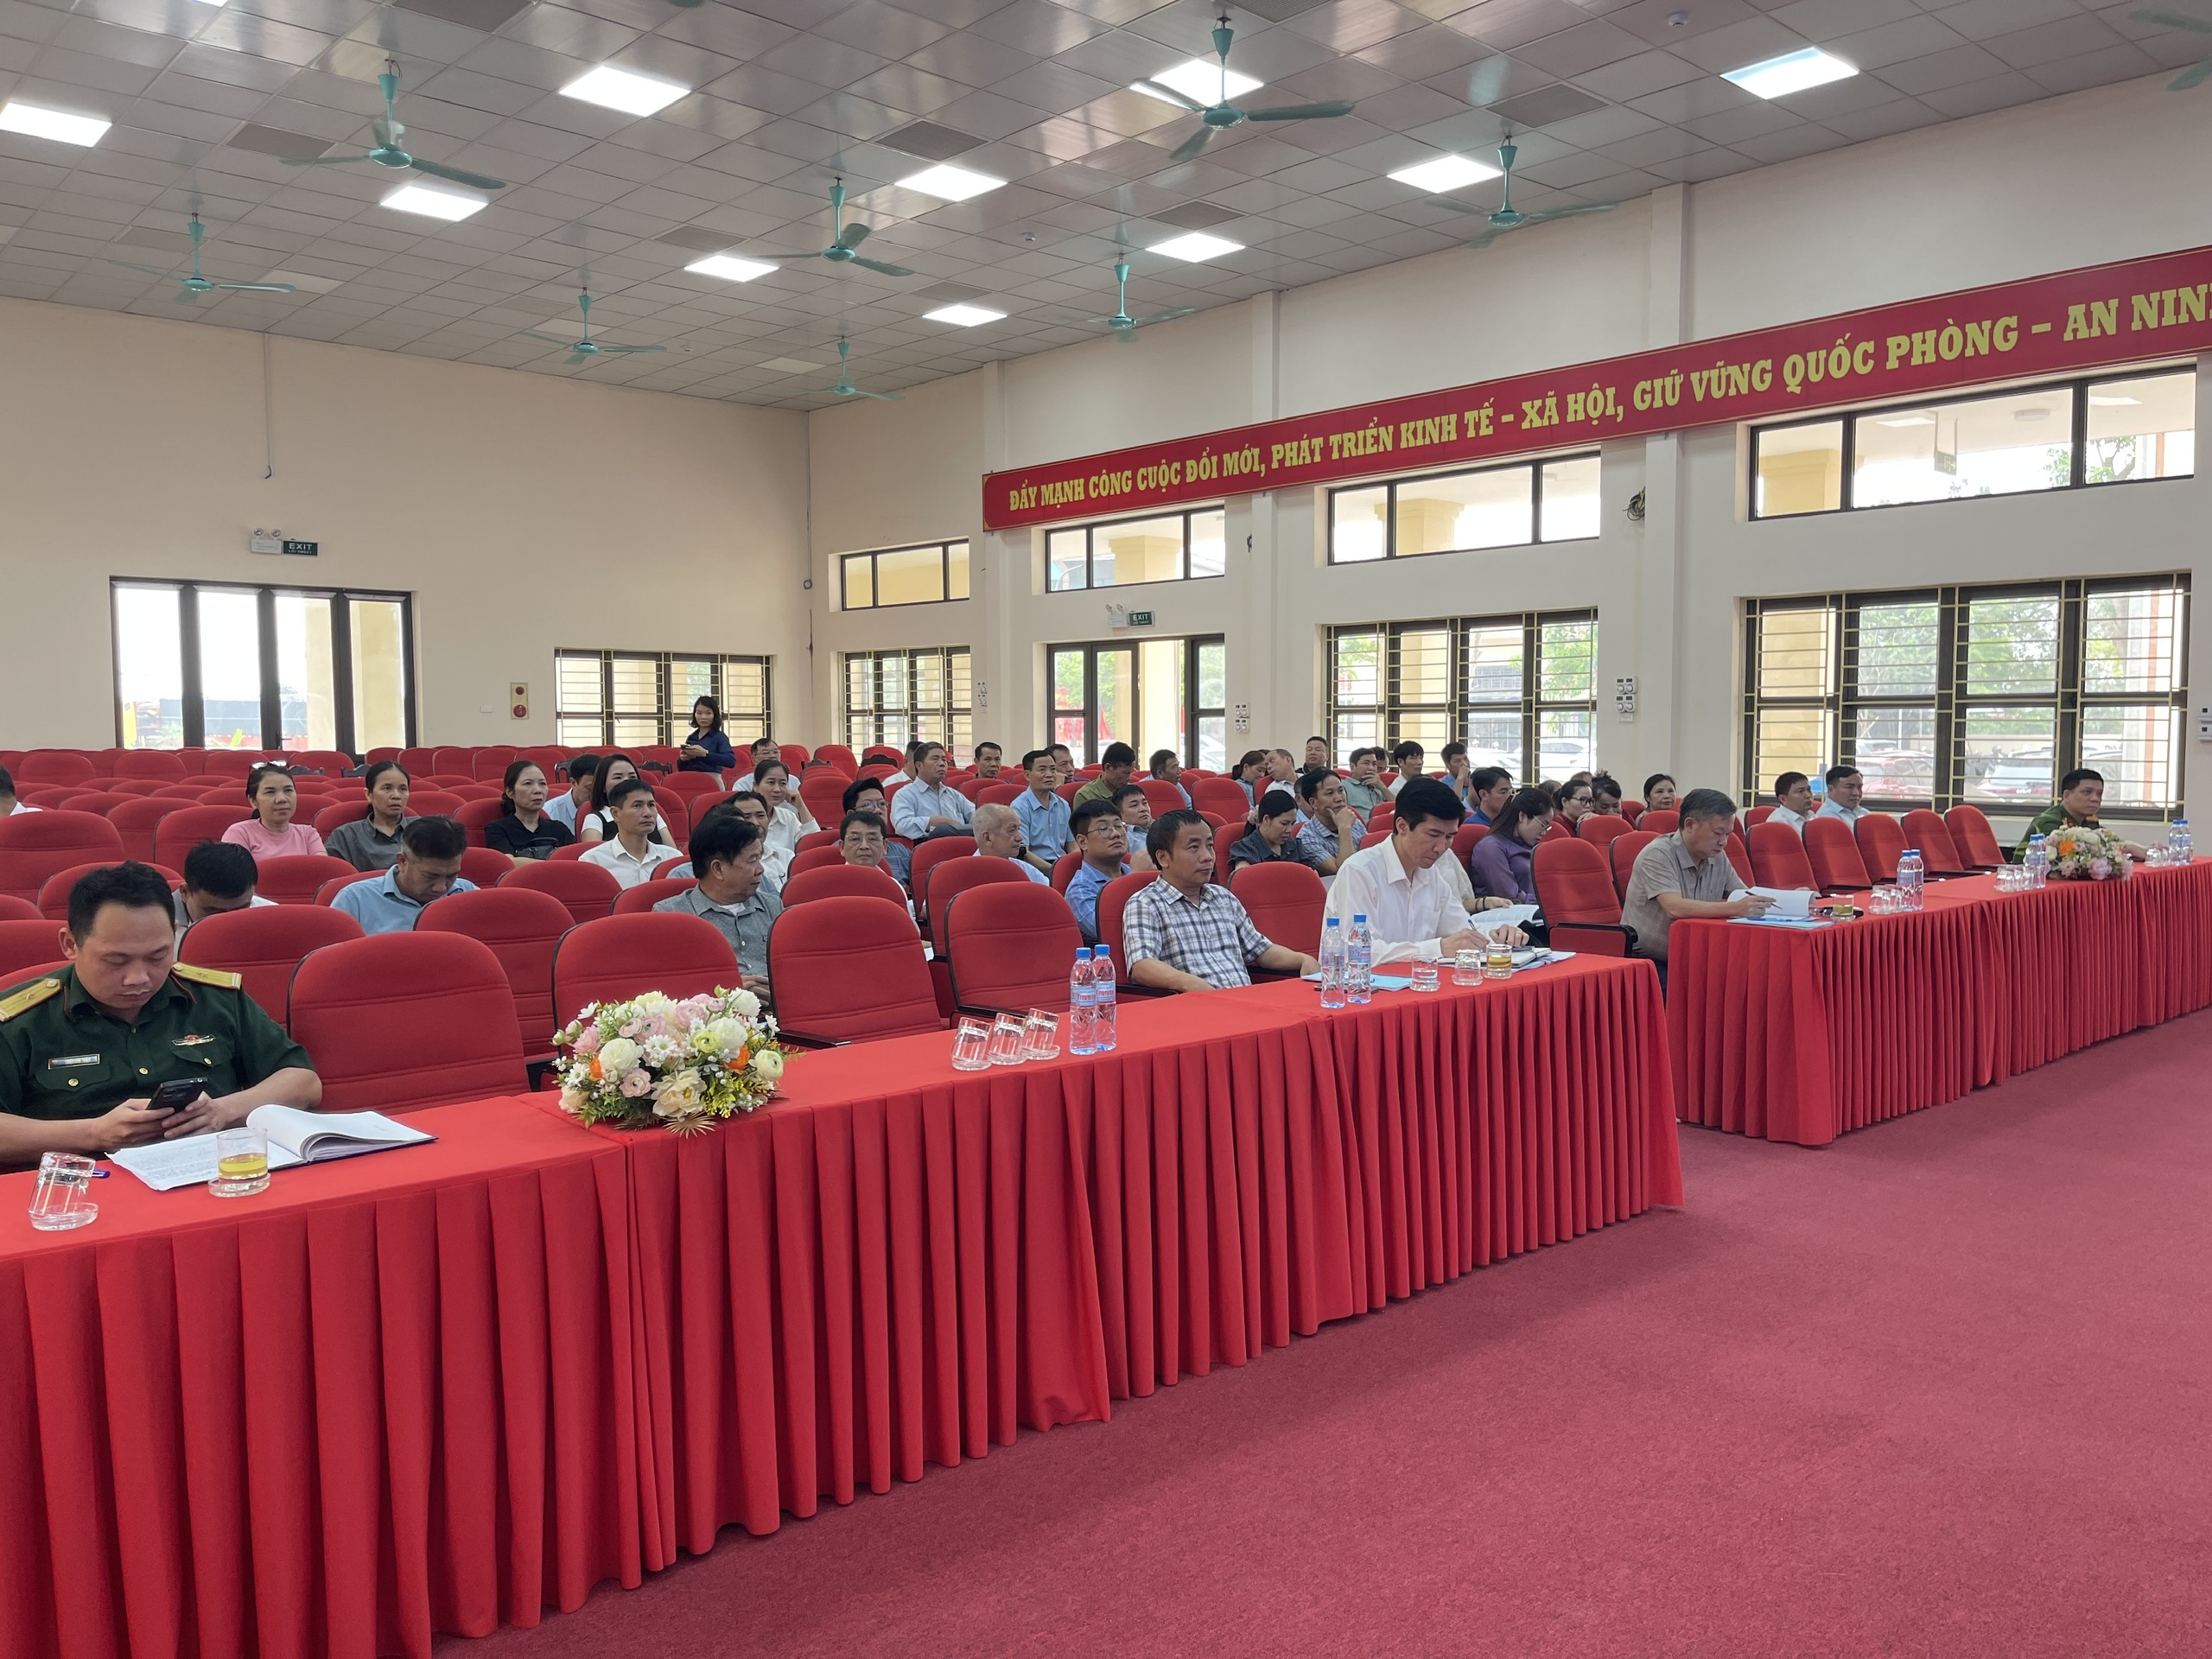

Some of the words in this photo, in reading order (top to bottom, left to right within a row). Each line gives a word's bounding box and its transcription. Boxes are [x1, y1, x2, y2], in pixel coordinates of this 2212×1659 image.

[1009, 479, 1038, 511] ĐẨY
[1040, 478, 1085, 509] MẠNH
[1089, 469, 1133, 499] CÔNG
[1136, 459, 1181, 493] CUỘC
[1185, 447, 1219, 483] ĐỔI
[1223, 443, 1267, 478] MỚI,
[1271, 434, 1324, 469] PHÁT
[1329, 416, 1395, 460] TRIỂN
[1400, 414, 1458, 449] KINH
[1464, 397, 1495, 438] TẾ
[1521, 391, 1560, 430] XÃ
[1567, 383, 1624, 426] HỘI,
[1633, 368, 1684, 410] GIỮ
[1690, 360, 1773, 402] VỮNG
[1783, 333, 1875, 395] QUỐC
[1885, 315, 2018, 370] PHÒNG
[2063, 298, 2120, 342] AN
[2131, 283, 2212, 332] NIN
[289, 542, 313, 550] EXIT
